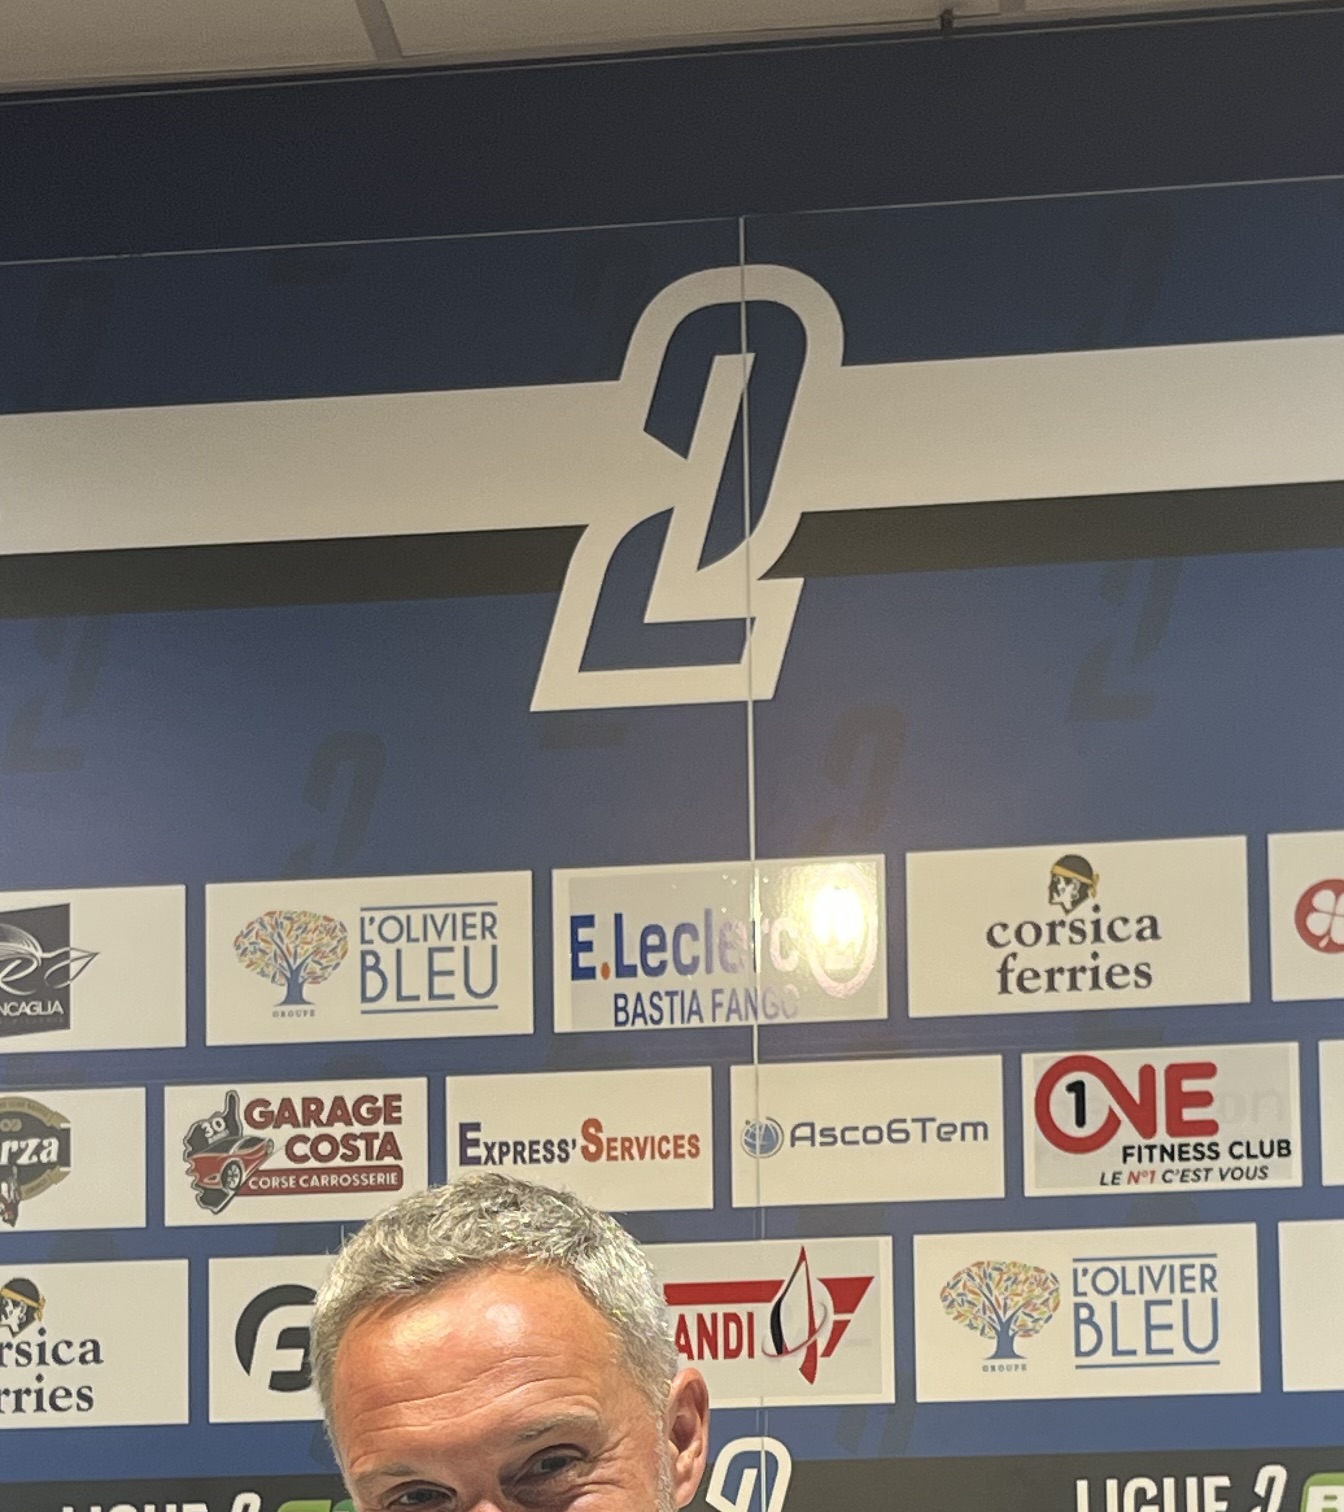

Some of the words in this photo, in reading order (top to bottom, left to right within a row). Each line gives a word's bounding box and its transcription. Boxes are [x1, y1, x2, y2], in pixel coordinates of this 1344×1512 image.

[360, 912, 497, 944] L'OLIVIER
[987, 904, 1162, 948] corsica
[360, 945, 497, 1003] BLEU
[997, 951, 1152, 994] ferries
[244, 1094, 402, 1129] GARAGE
[285, 1131, 402, 1163] COSTA
[790, 1117, 988, 1147] Asco6Tem
[1123, 1142, 1220, 1164] FITNESS
[1229, 1139, 1291, 1159] CLUB
[249, 1176, 295, 1189] CORSE
[299, 1173, 397, 1187] CARROSSERIE
[1100, 1171, 1122, 1186] LE
[1162, 1168, 1213, 1183] C'EST
[1219, 1166, 1269, 1181] VOUS
[1073, 1264, 1217, 1297] L'OLIVIER
[1074, 1298, 1218, 1357] BLEU
